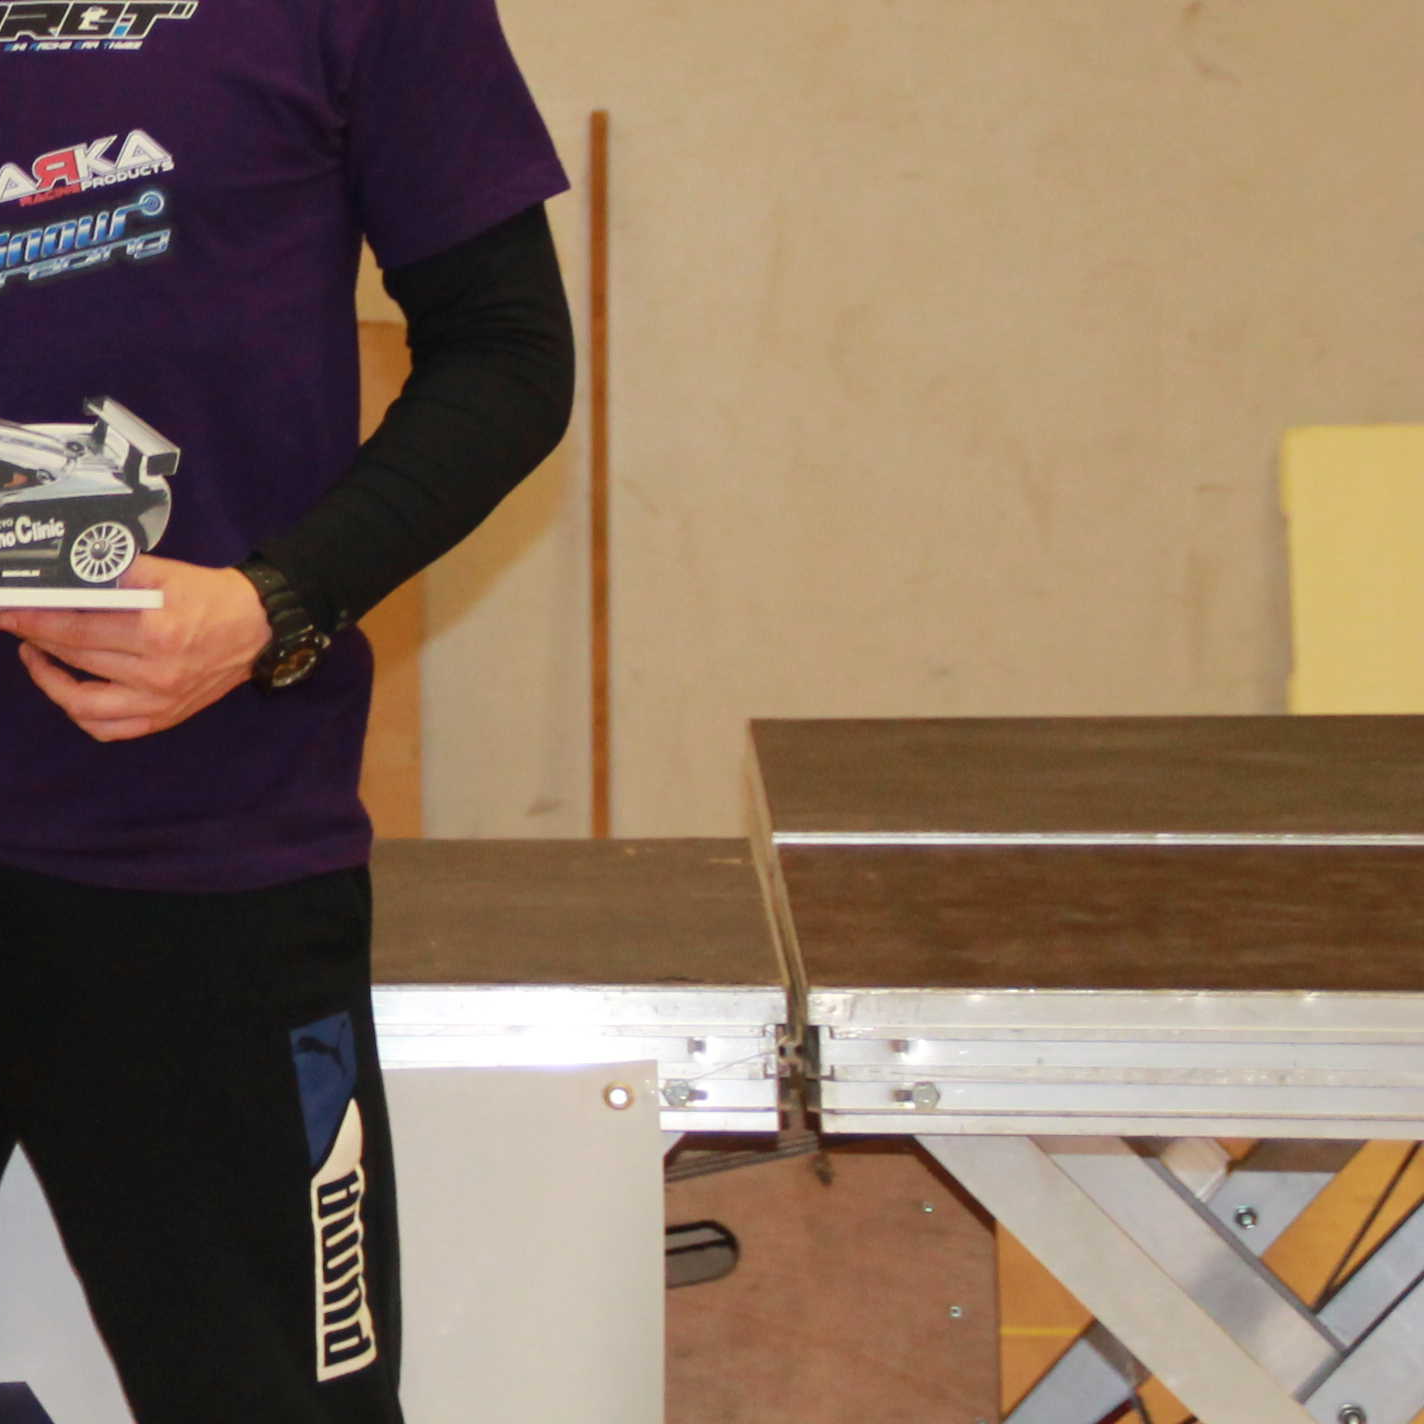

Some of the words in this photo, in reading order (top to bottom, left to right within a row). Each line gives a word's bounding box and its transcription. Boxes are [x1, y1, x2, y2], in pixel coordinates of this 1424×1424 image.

[80, 158, 176, 192] PRODUCTS
[15, 515, 65, 544] Clinic
[311, 1167, 377, 1382] PUMA
